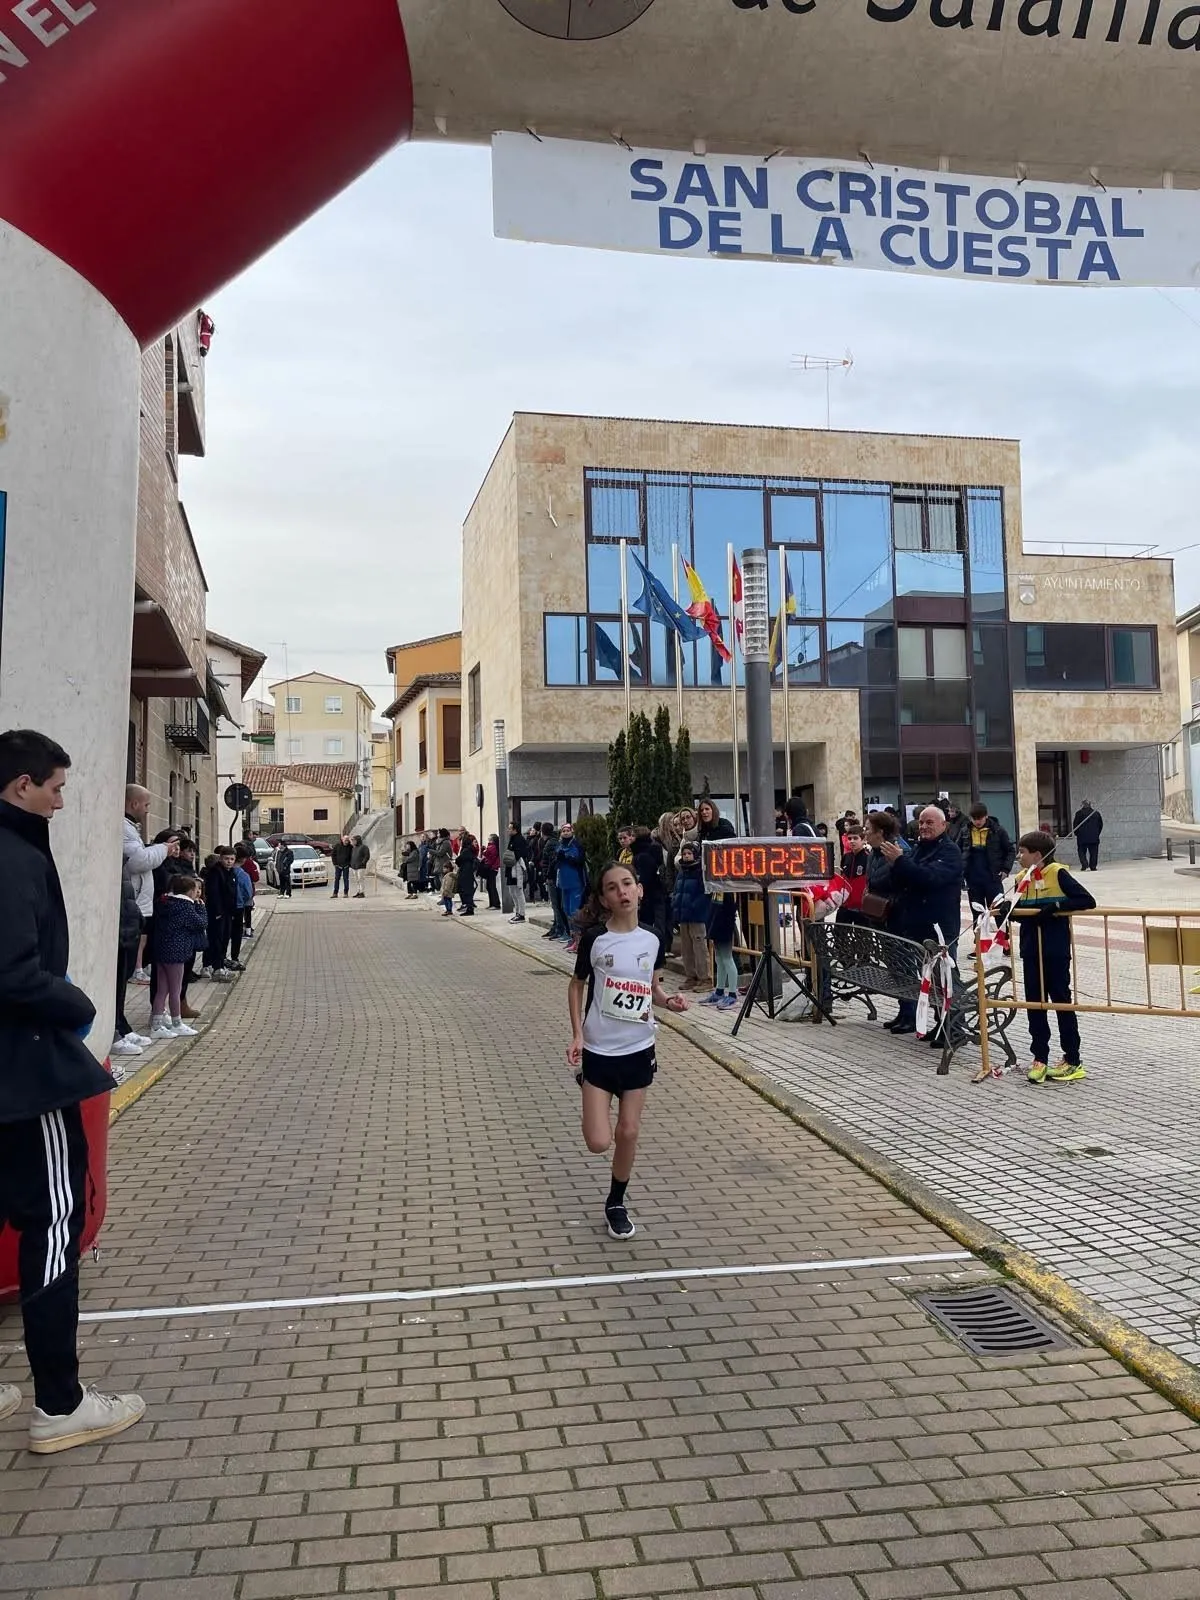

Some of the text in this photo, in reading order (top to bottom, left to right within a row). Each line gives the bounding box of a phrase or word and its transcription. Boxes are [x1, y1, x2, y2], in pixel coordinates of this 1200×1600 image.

[630, 158, 1144, 238] SAN CRISTOBAL
[659, 206, 1120, 281] DE LA CUESTA
[1043, 576, 1141, 591] AYUNTAMIENTO
[612, 992, 645, 1011] 437
